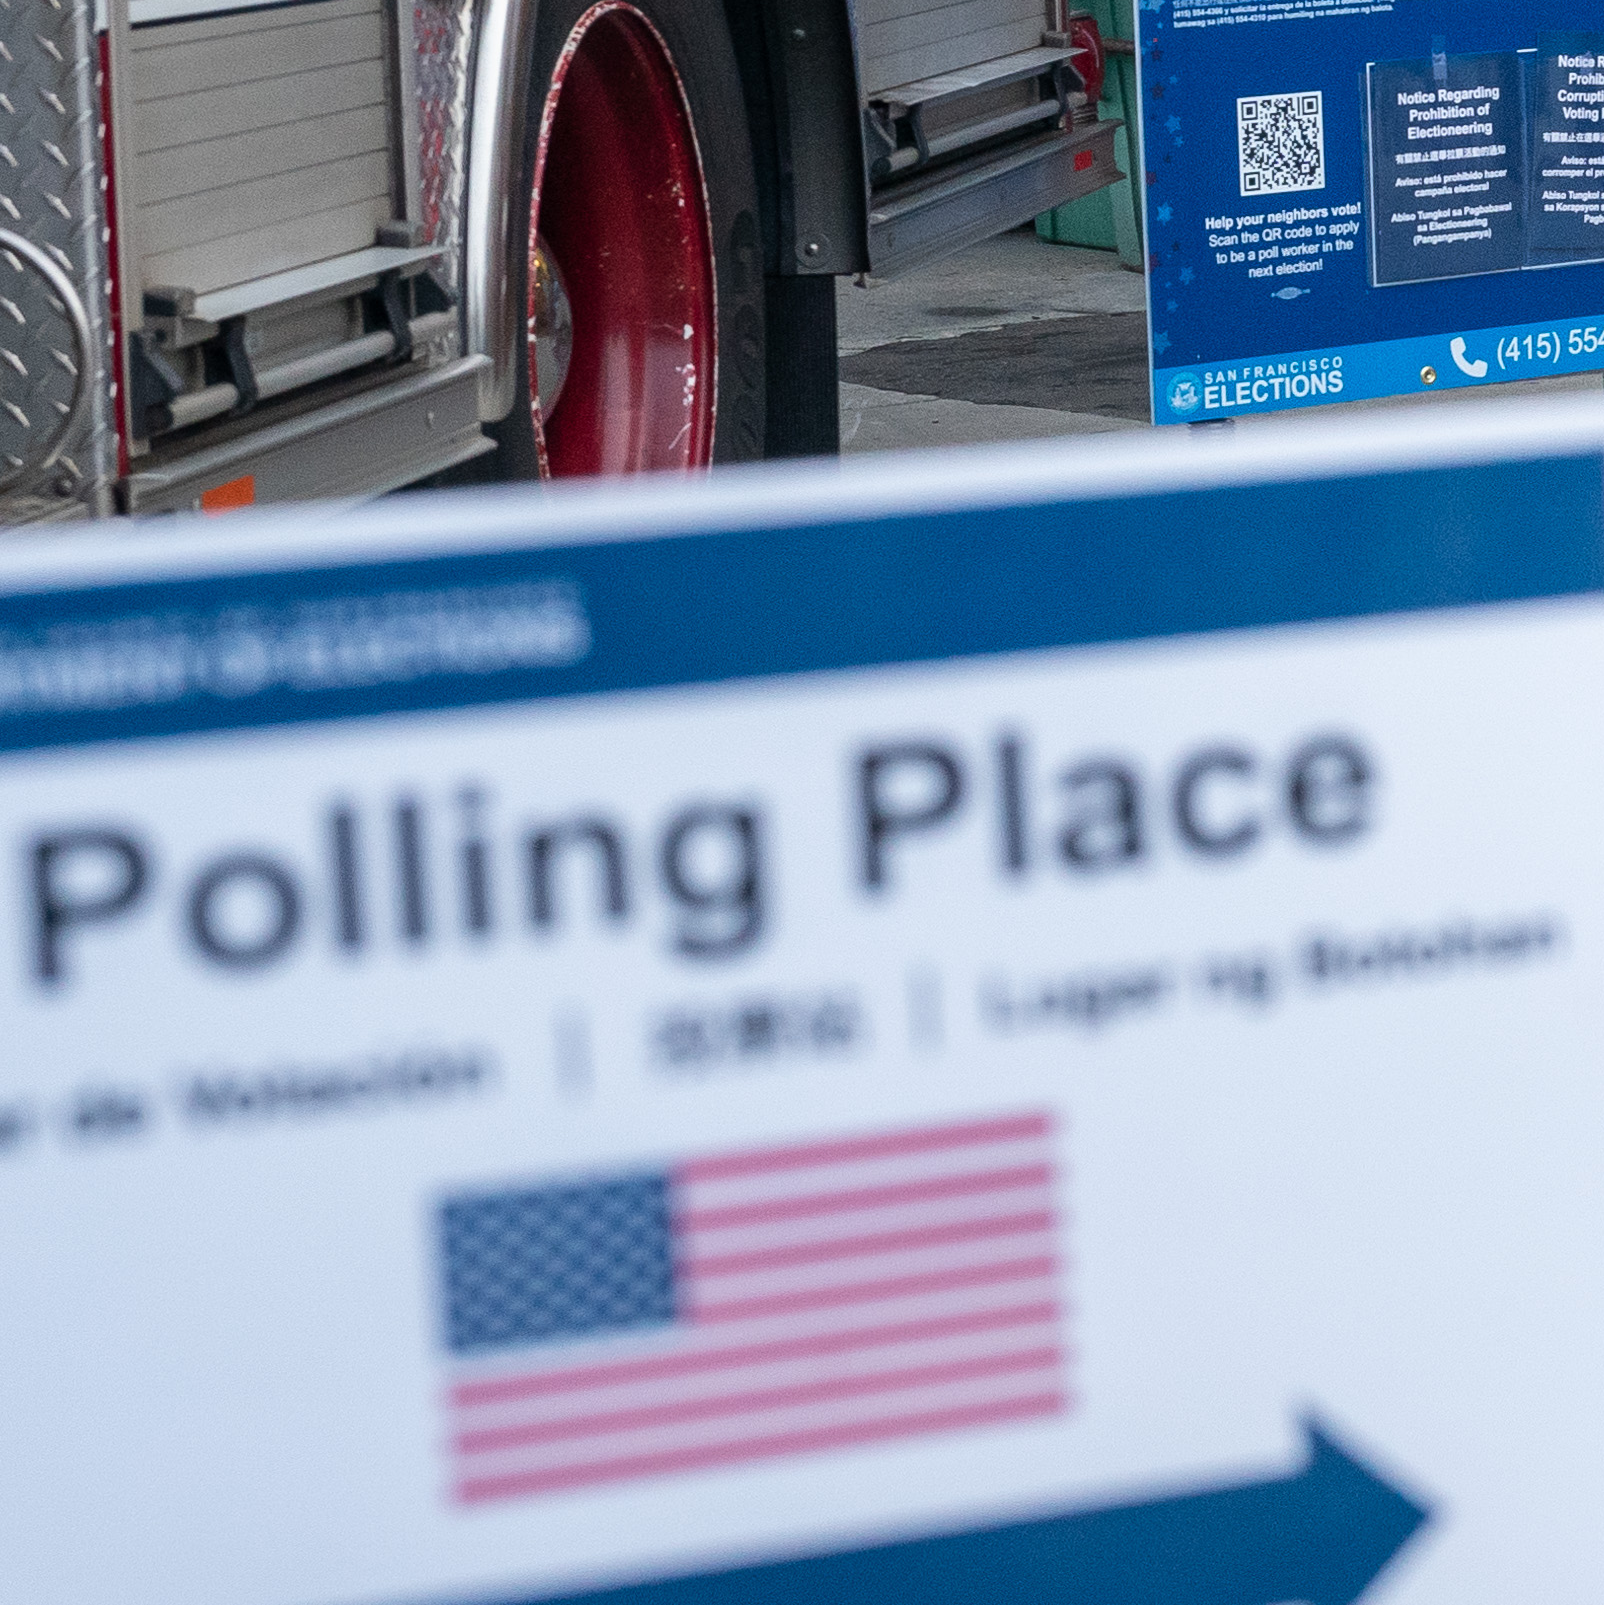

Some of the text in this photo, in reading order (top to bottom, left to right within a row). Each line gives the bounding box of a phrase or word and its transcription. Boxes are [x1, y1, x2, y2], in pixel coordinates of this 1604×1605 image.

[1204, 201, 1361, 230] Help your neighbors vote!
[1208, 221, 1359, 247] Scan the QR code to apply
[1215, 239, 1354, 264] to be a poll worker in the
[1248, 258, 1323, 278] next election!
[1496, 331, 1560, 370] (415)
[1204, 355, 1342, 384] SAN FRANCISCO
[1204, 369, 1344, 409] ELECTIONS
[24, 724, 1376, 996] Polling Place
